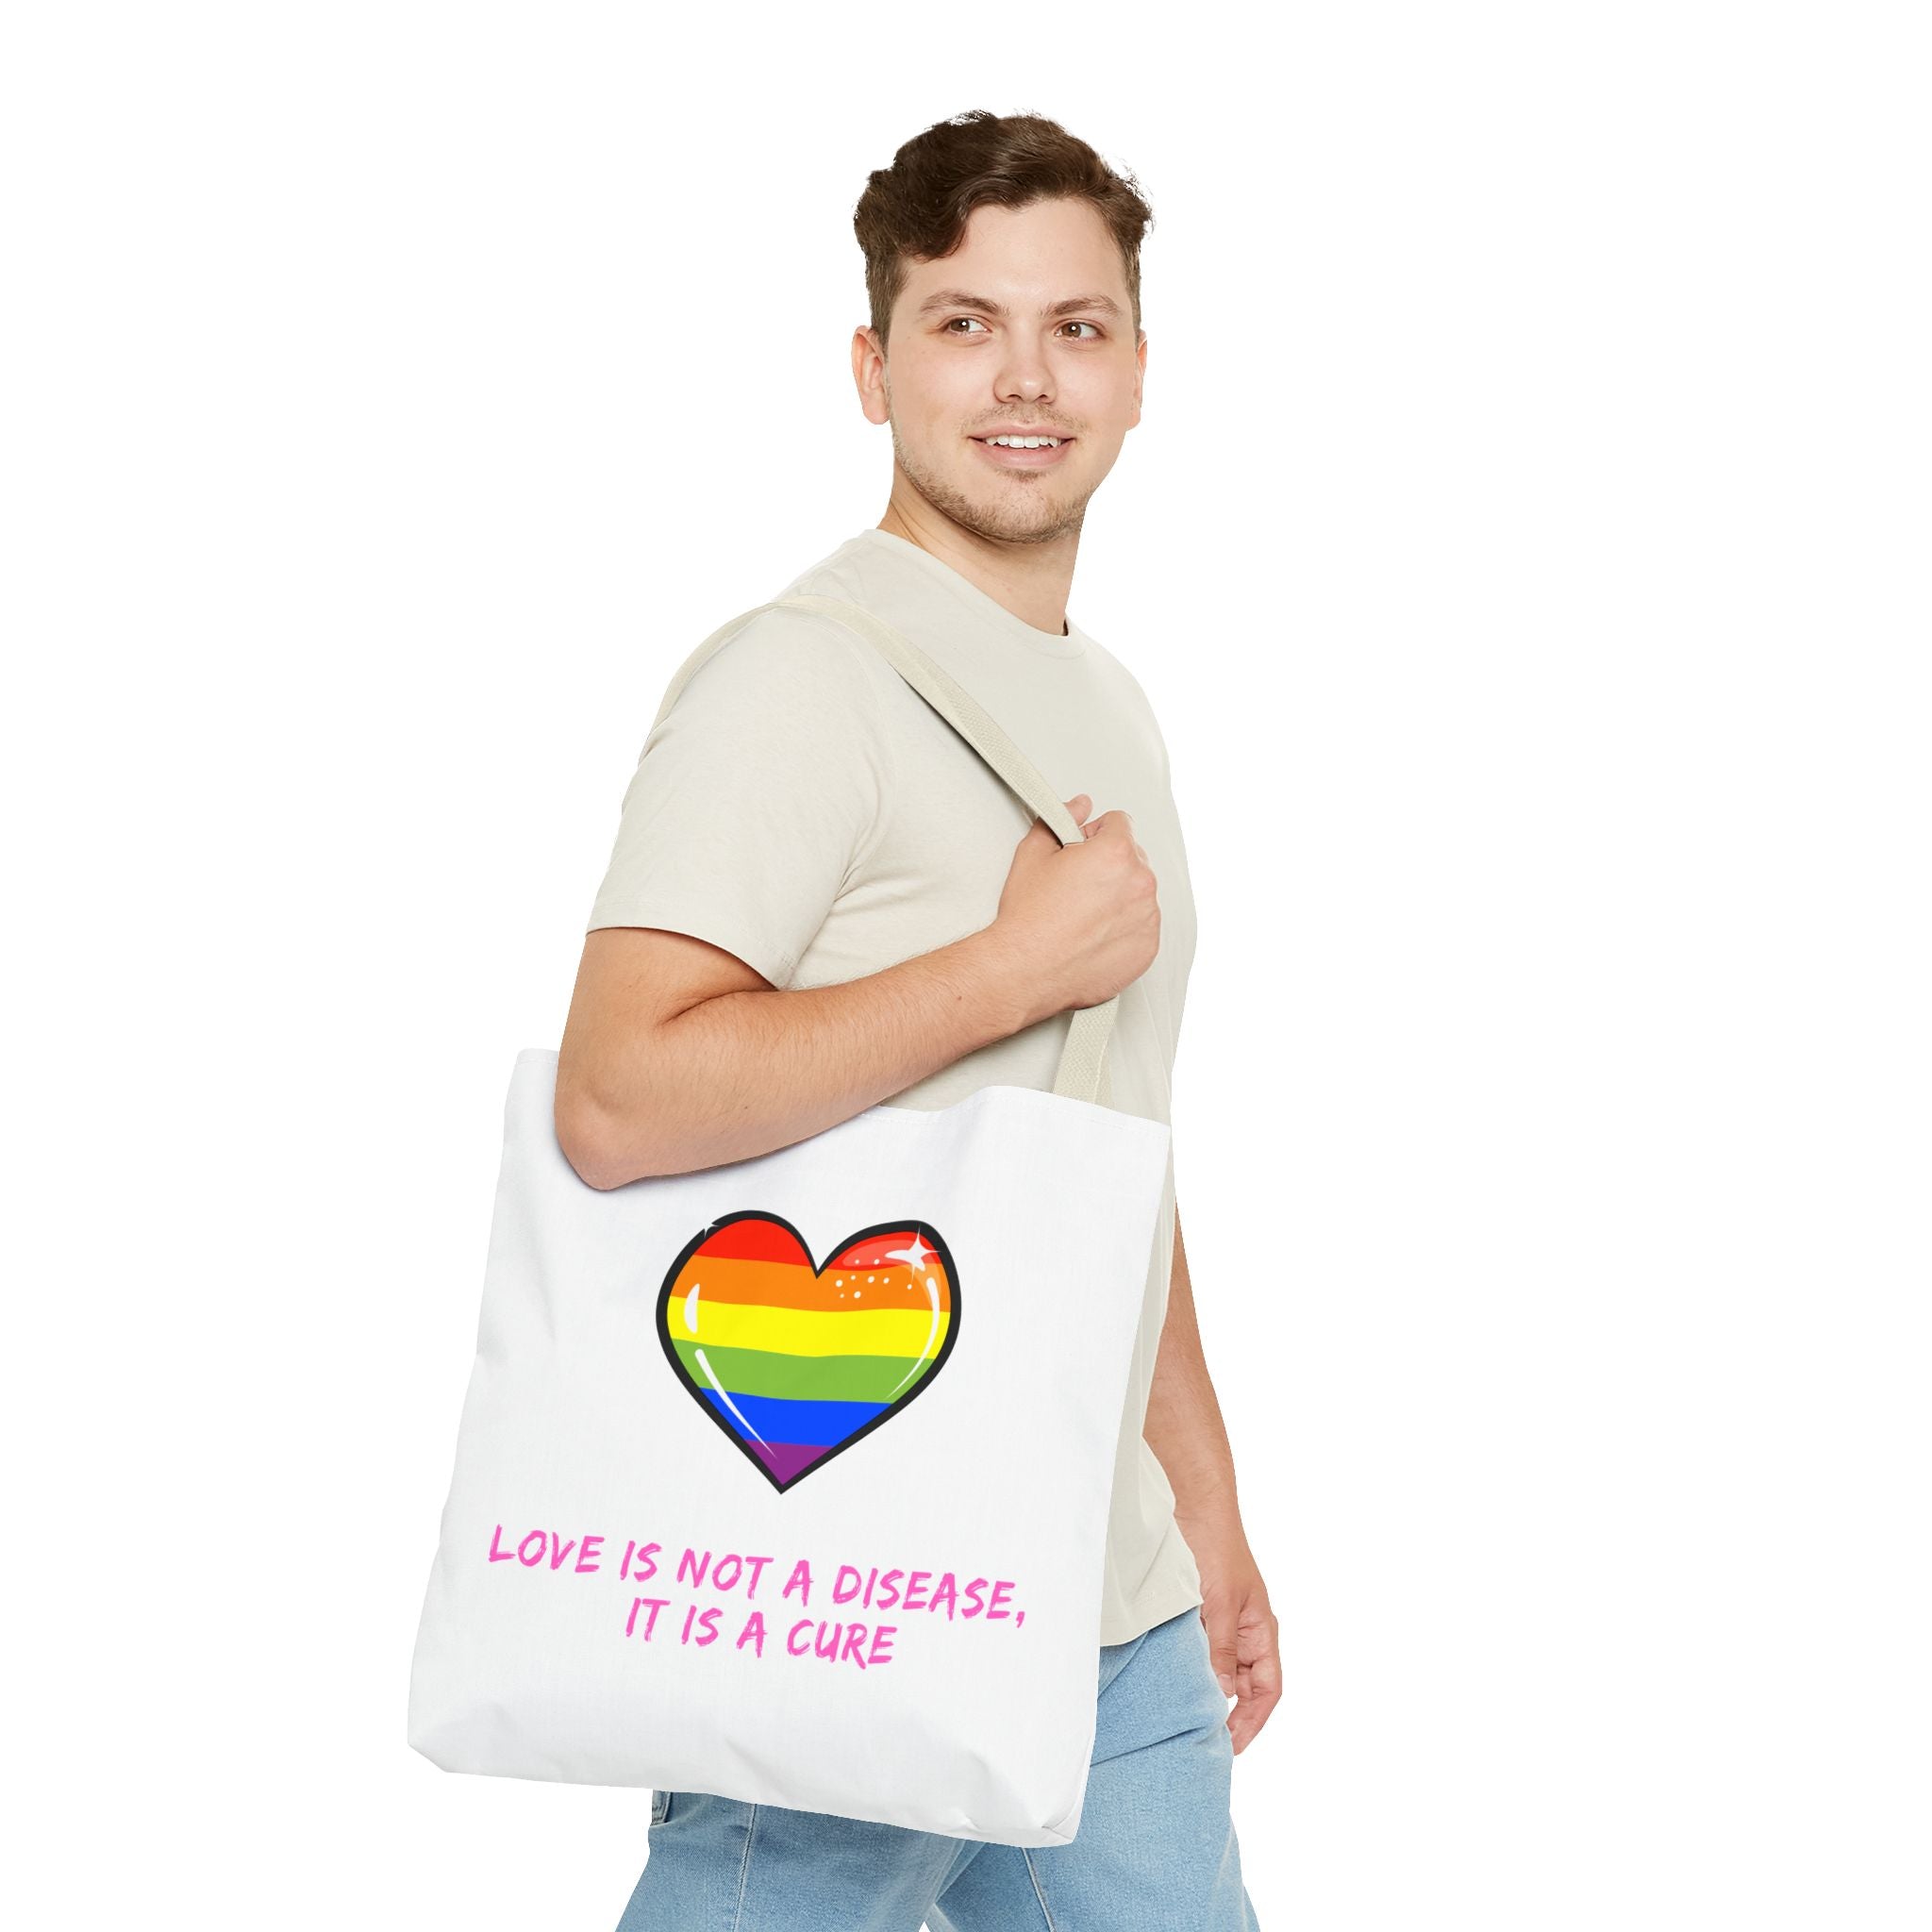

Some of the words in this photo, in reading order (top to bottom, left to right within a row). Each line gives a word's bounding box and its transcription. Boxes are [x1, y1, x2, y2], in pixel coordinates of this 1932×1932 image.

[489, 1524, 605, 1574] LOVE
[620, 1540, 662, 1583] IS
[676, 1548, 774, 1600] NOT
[782, 1559, 814, 1607] A
[832, 1564, 1026, 1628] DISEASE,
[625, 1598, 671, 1642] IT
[681, 1604, 724, 1646] IS
[736, 1611, 768, 1658] A
[787, 1619, 898, 1670] CURE
